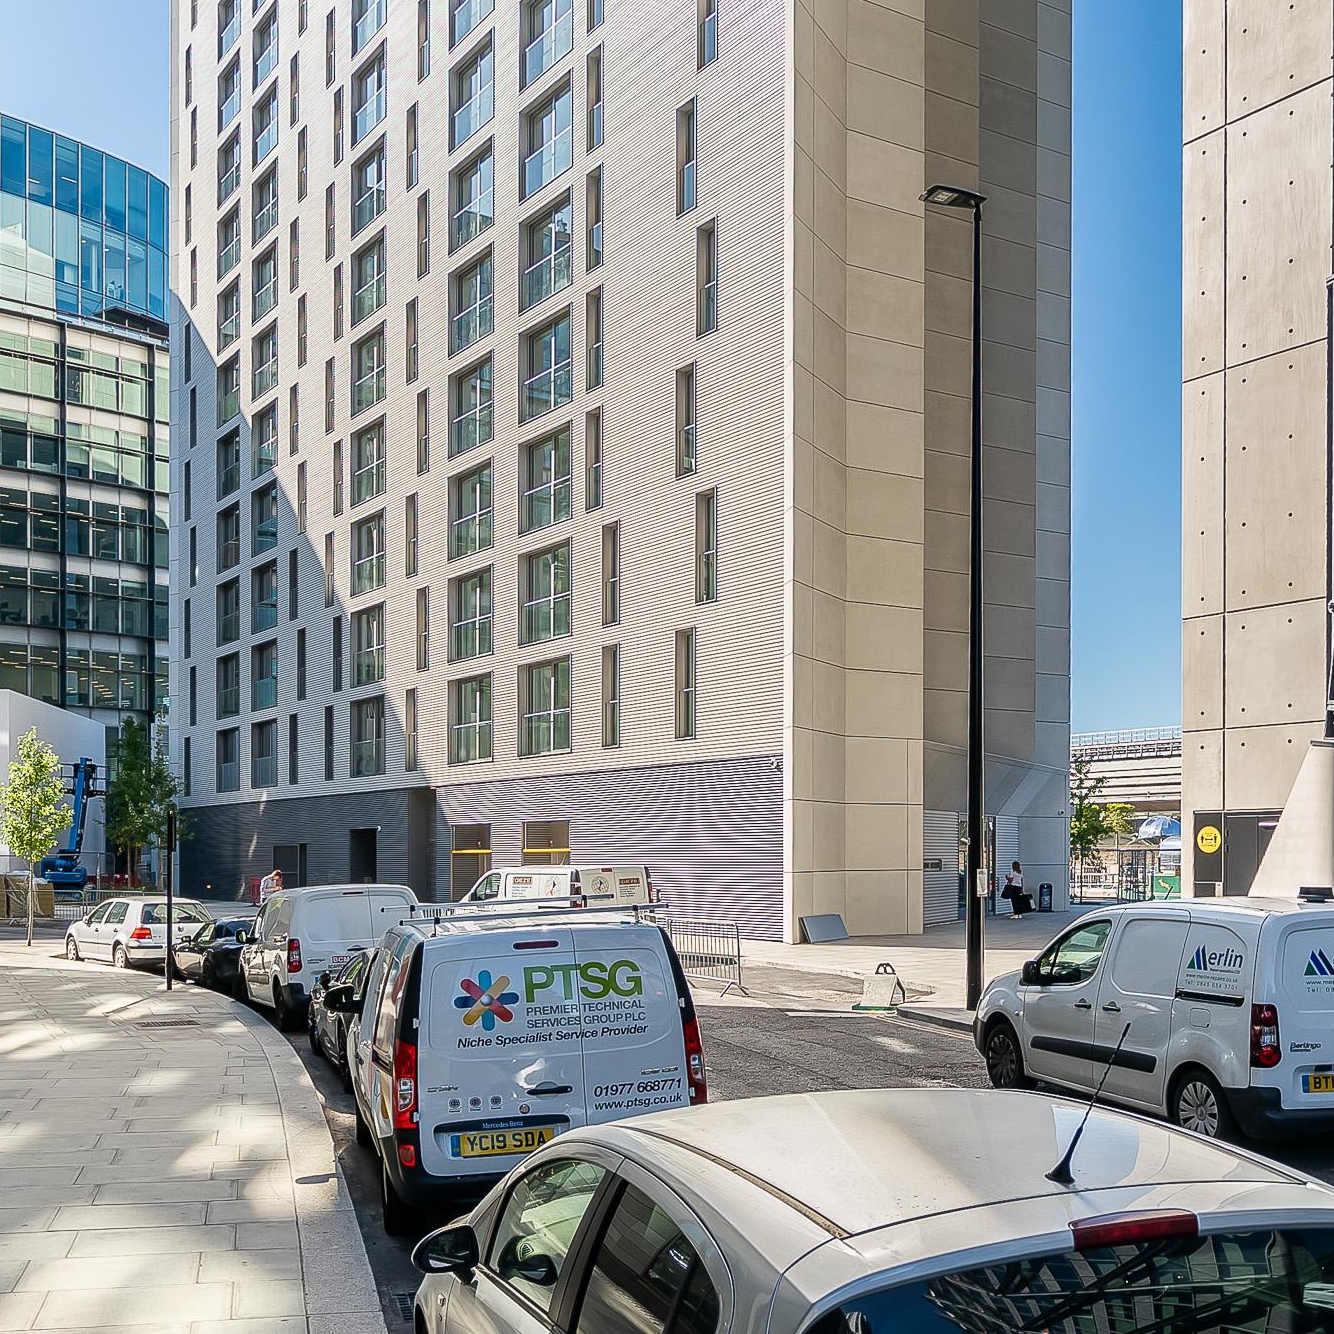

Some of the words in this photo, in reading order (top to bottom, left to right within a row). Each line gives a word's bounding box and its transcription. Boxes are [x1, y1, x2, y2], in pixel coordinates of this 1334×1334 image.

[1186, 944, 1243, 971] Merlin
[522, 959, 643, 1003] PTSG
[526, 1003, 579, 1016] PREMIER
[581, 1000, 645, 1013] TECHNICAL
[526, 1016, 581, 1029] SERVICES
[583, 1014, 624, 1025] GROUP
[624, 1012, 647, 1022] PLC
[457, 1036, 493, 1049] Niche
[495, 1031, 553, 1047] Specialist
[555, 1028, 599, 1040] Service
[600, 1023, 649, 1037] Provider
[1290, 1042, 1322, 1050] Berlingo
[593, 1082, 634, 1098] 01977
[636, 1077, 682, 1093] 668771
[594, 1092, 683, 1110] www.ptsg.co.uk
[482, 1120, 524, 1130] Mercedes-Benz
[467, 1133, 507, 1152] YC19
[512, 1130, 547, 1148] SDA
